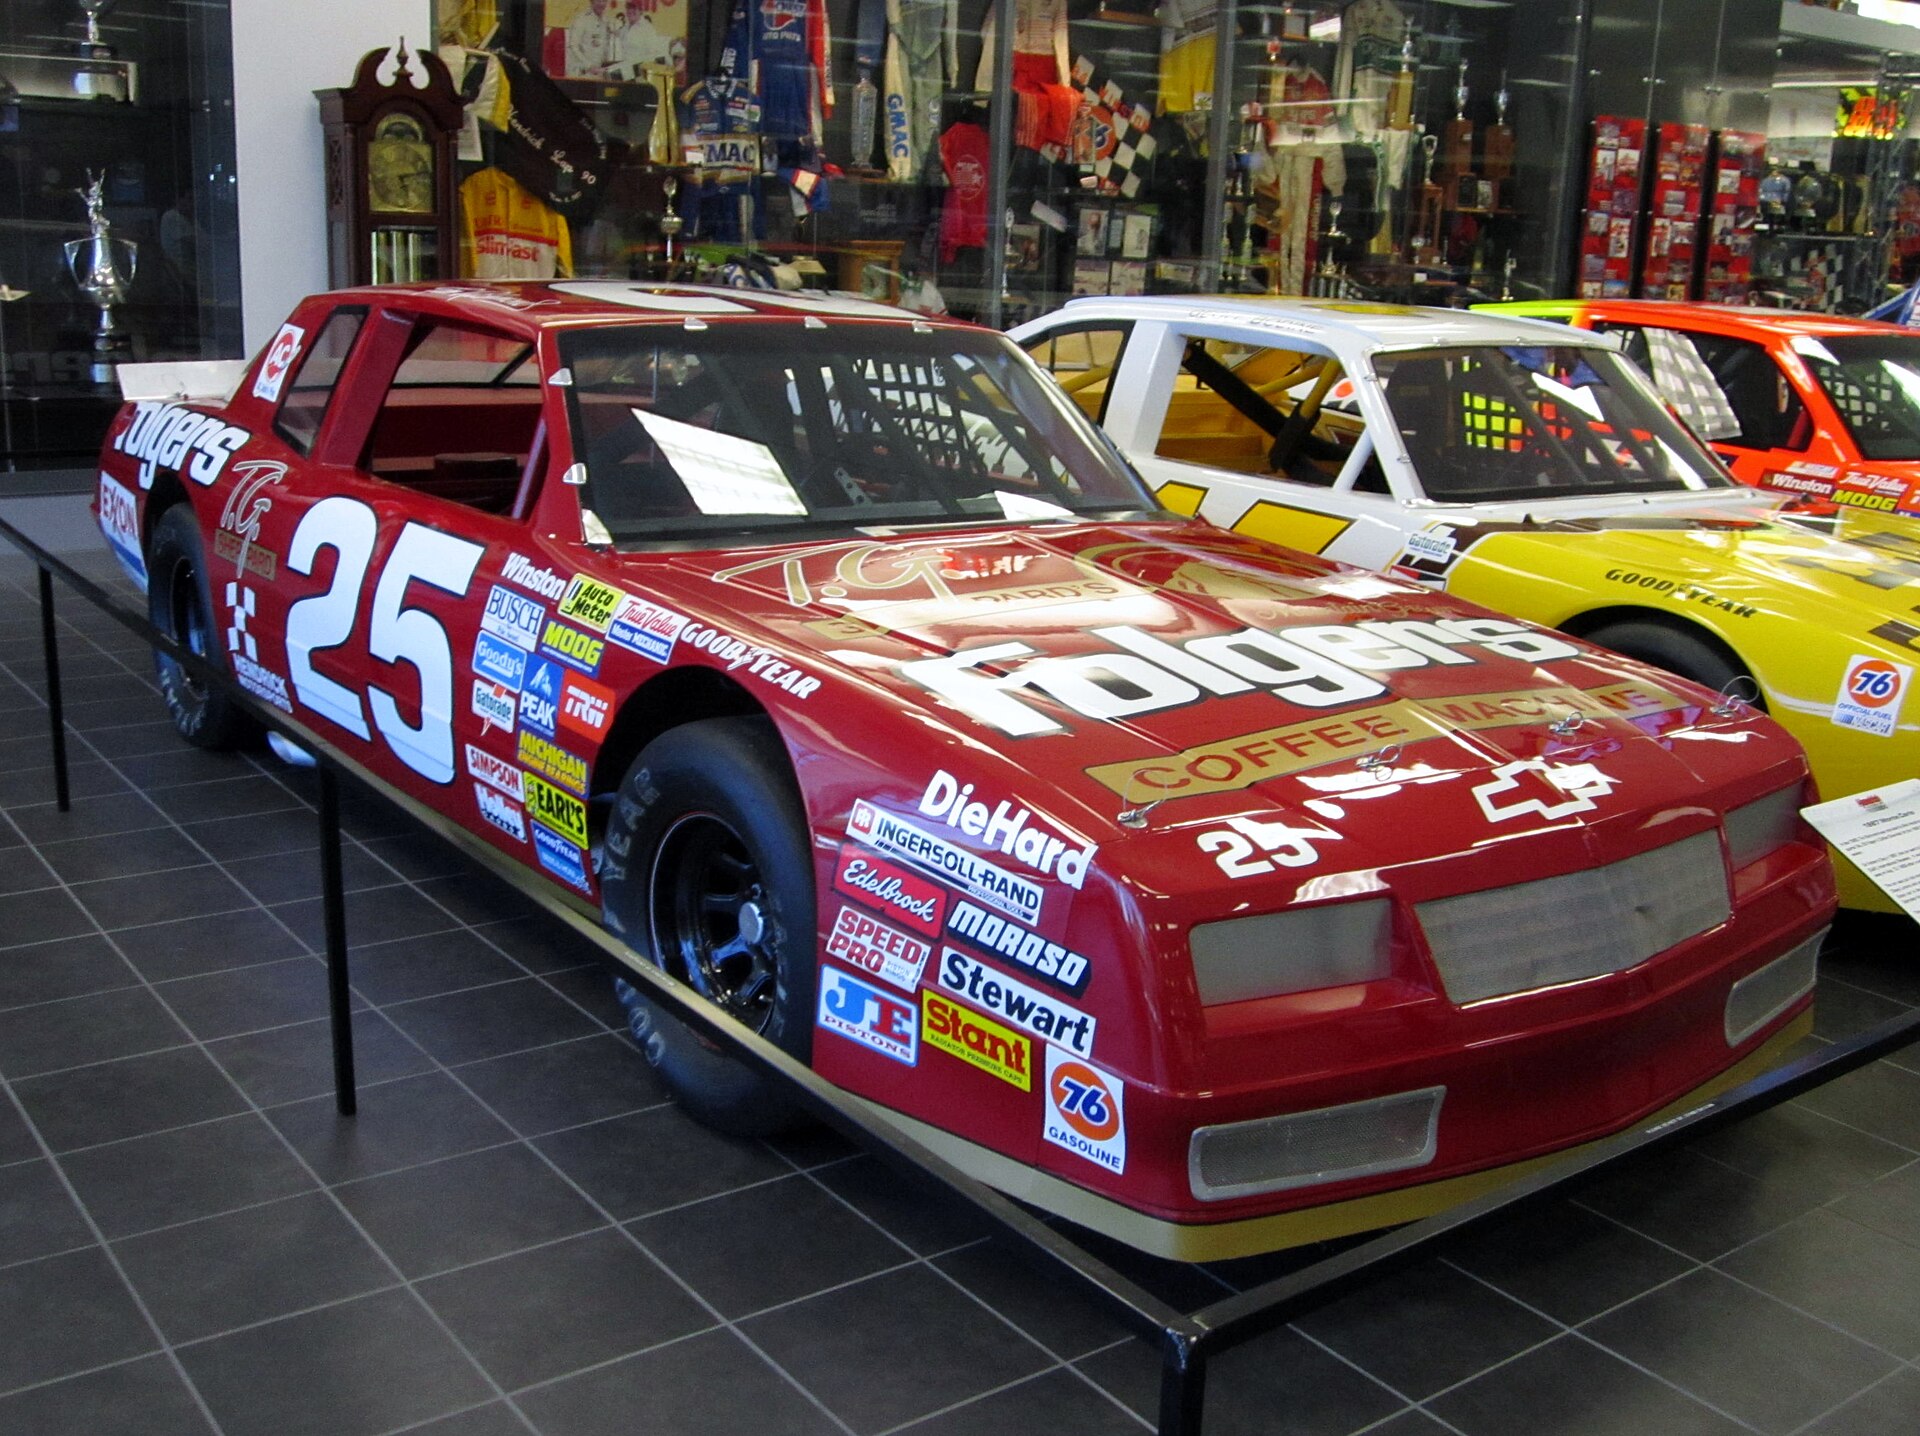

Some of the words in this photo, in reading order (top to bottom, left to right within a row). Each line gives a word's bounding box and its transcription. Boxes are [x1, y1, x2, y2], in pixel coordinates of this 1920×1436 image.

[887, 93, 911, 158] GMAC
[1770, 473, 1833, 495] Winston
[1830, 489, 1899, 512] MOOG
[1407, 532, 1451, 555] Gatorade
[501, 552, 567, 601] Winston
[581, 584, 614, 607] Auto
[1604, 568, 1759, 619] GOODYEAR
[486, 588, 543, 636] BUSCH
[573, 598, 612, 625] Meter
[286, 495, 487, 786] 25
[477, 641, 522, 675] Goody's
[542, 621, 605, 667] MOOG
[681, 623, 822, 700] GOODYEAR
[902, 618, 1580, 738] Folgers
[1852, 670, 1896, 697] 76
[519, 690, 557, 730] PEAK
[564, 685, 609, 729] TRW
[470, 747, 520, 792] SIMPSON
[519, 729, 587, 782] MICHIGAN
[1132, 714, 1408, 791] COFFEE
[536, 782, 585, 836] EARL'S
[917, 769, 1099, 890] DieHard
[876, 816, 1040, 910] INGERSOLL-RAND
[1197, 820, 1321, 878] 25
[842, 859, 935, 923] Edelbrock
[829, 934, 886, 973] PRO
[838, 909, 923, 965] SPEED
[824, 974, 914, 1049] JE
[943, 952, 1091, 1053] Stewart
[824, 1014, 912, 1061] PISTONS
[926, 997, 1028, 1077] Stant
[1060, 1077, 1110, 1126] 76
[1049, 1126, 1122, 1170] GASOLINE
